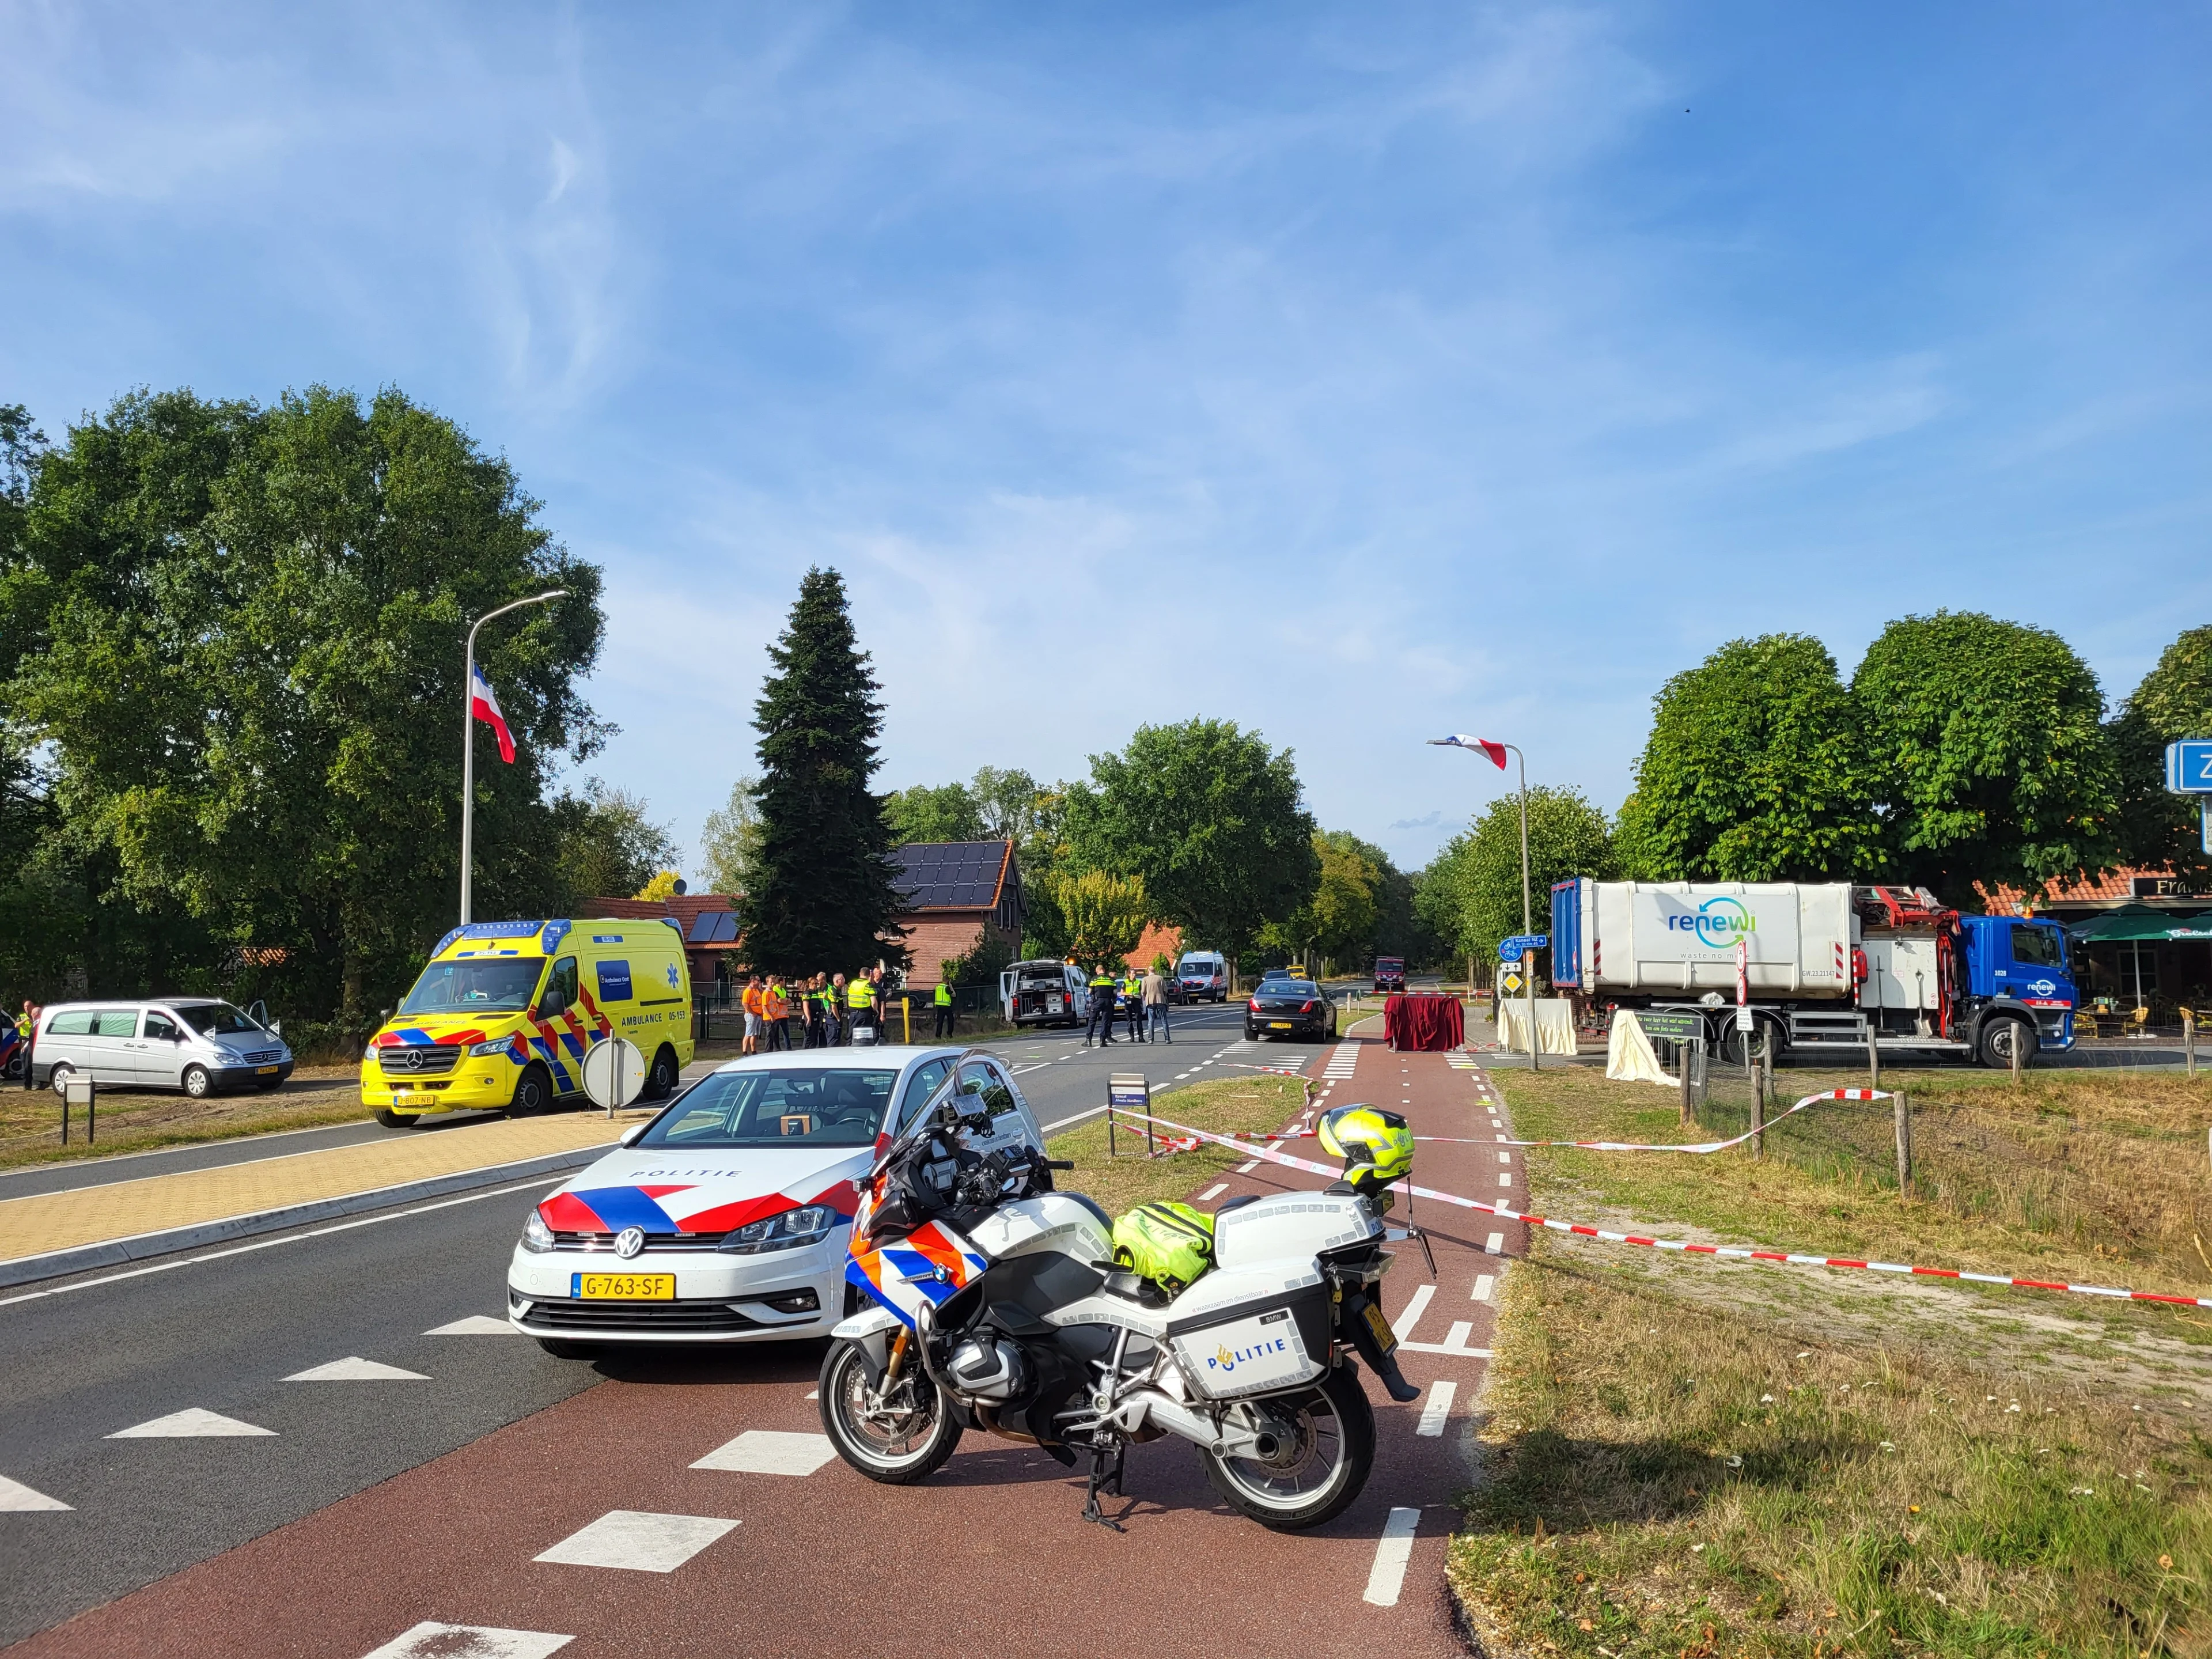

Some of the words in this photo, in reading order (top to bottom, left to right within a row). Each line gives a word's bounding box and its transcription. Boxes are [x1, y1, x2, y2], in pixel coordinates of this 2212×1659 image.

[2156, 880, 2212, 894] Fra
[1669, 915, 1756, 931] renewi
[622, 1013, 662, 1027] AMBULANCE
[669, 1010, 685, 1021] 05-153
[586, 1278, 664, 1295] G-763-SF
[1266, 1313, 1282, 1323] BMW
[1207, 1339, 1286, 1372] POLITIE
